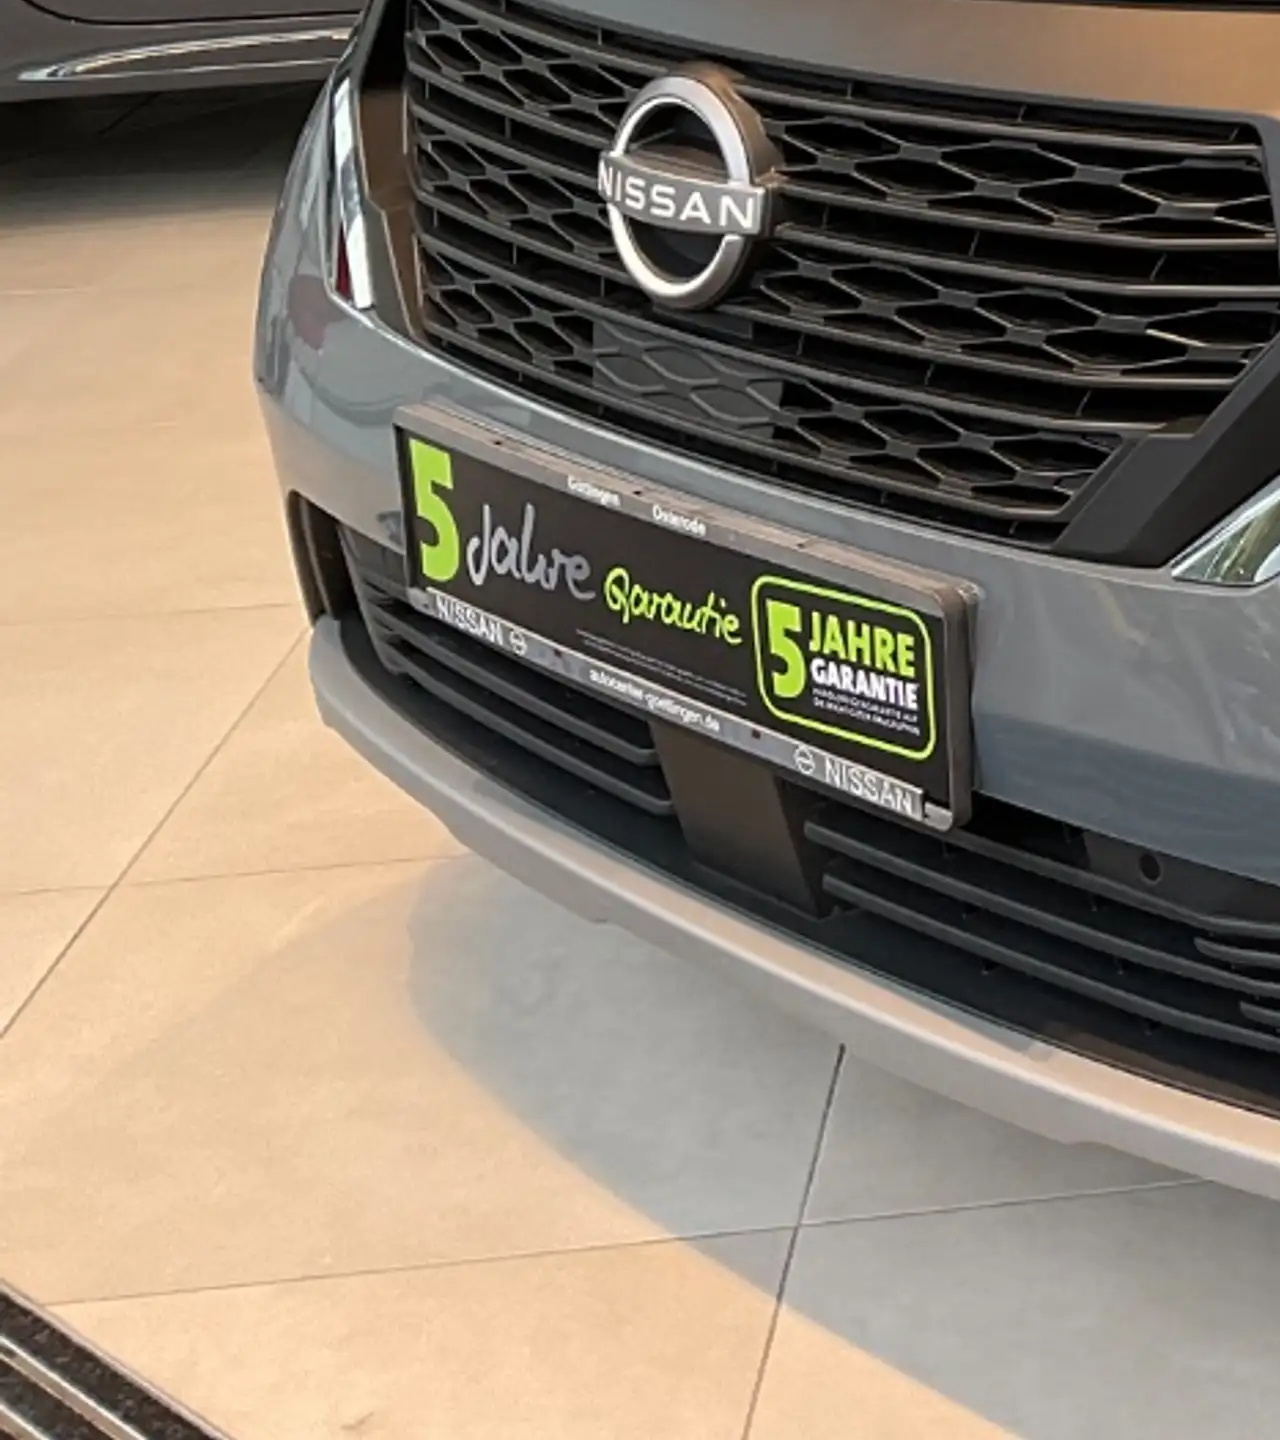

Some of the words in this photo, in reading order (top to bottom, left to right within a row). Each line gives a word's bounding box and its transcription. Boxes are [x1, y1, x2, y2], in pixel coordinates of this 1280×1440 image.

[598, 160, 754, 229] NISSAN
[409, 438, 461, 582] 5
[434, 593, 504, 644] NISSAN
[766, 598, 808, 698] 5
[809, 611, 915, 678] JAHRE
[810, 657, 920, 710] GARANTIE
[824, 758, 913, 816] NISSAN
